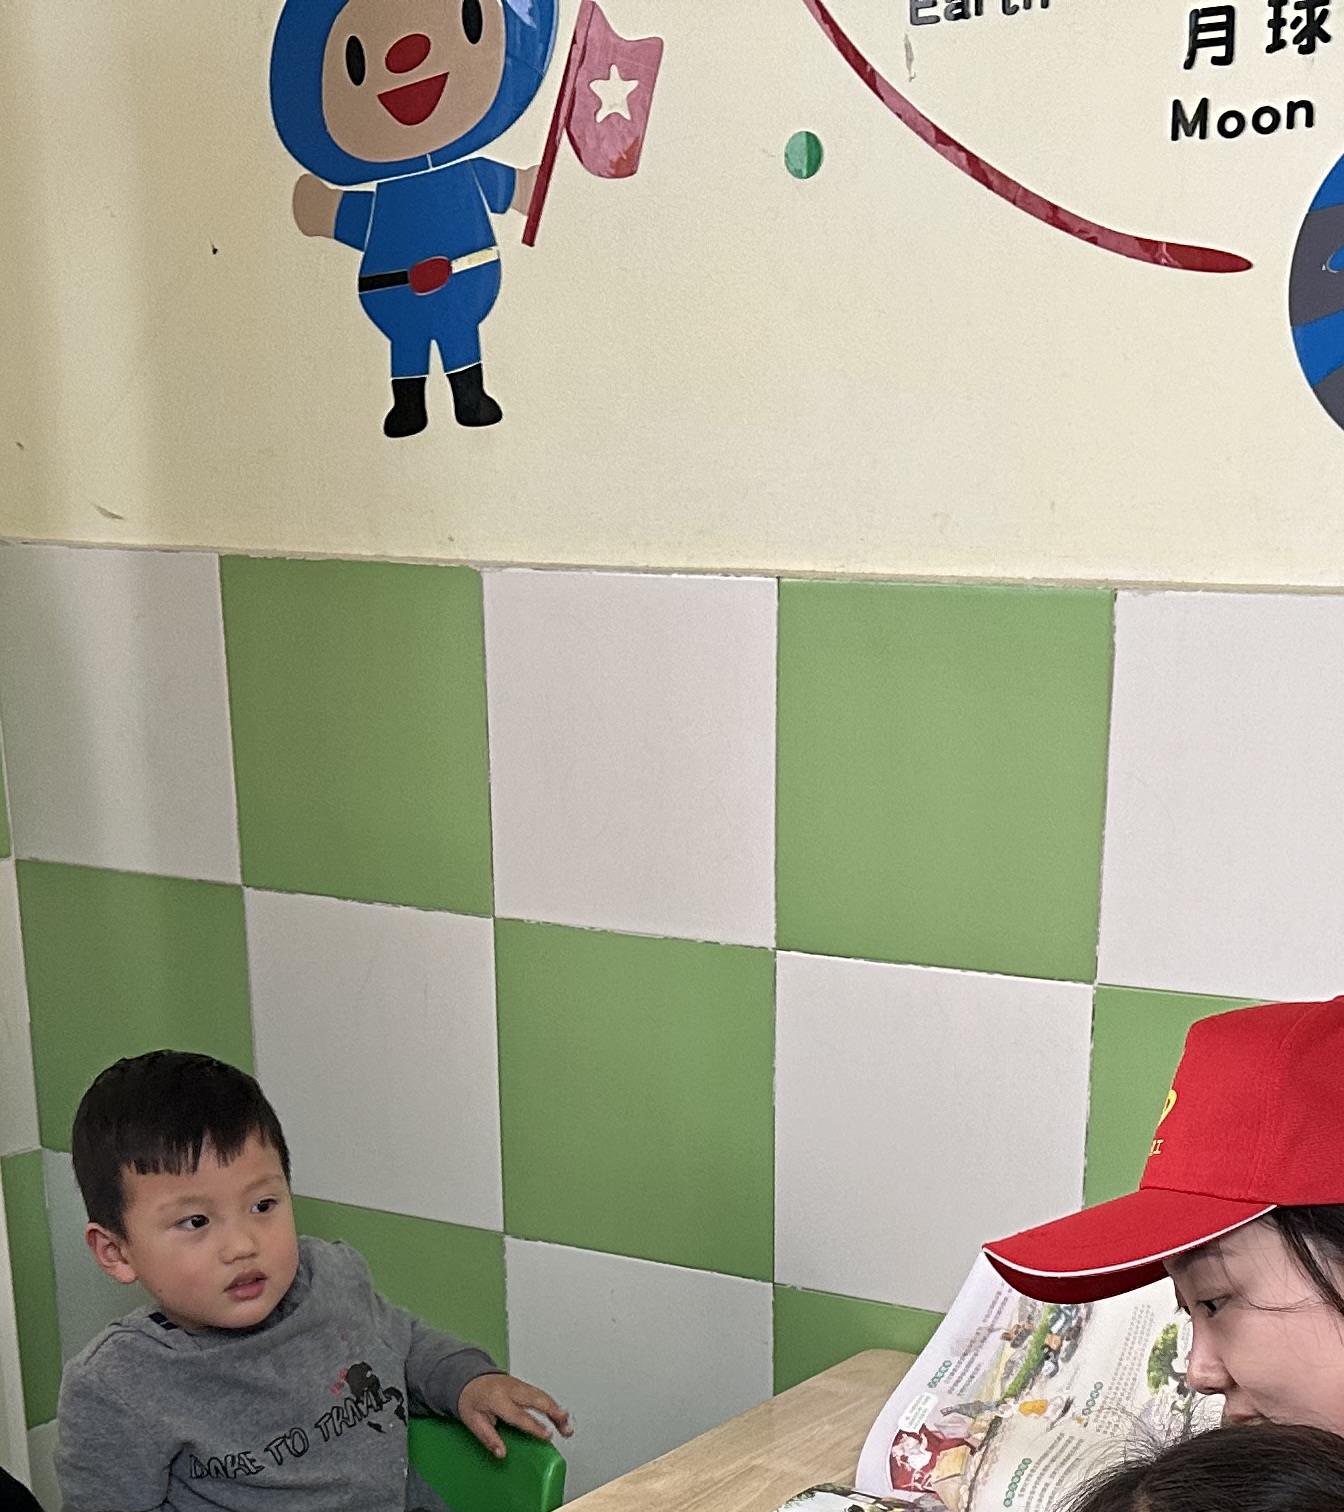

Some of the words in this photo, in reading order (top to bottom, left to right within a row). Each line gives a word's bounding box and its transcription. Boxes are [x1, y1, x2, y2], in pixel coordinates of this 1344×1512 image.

[1183, 0, 1333, 70] 月球
[1170, 97, 1314, 141] Moon
[264, 1427, 309, 1466] TO
